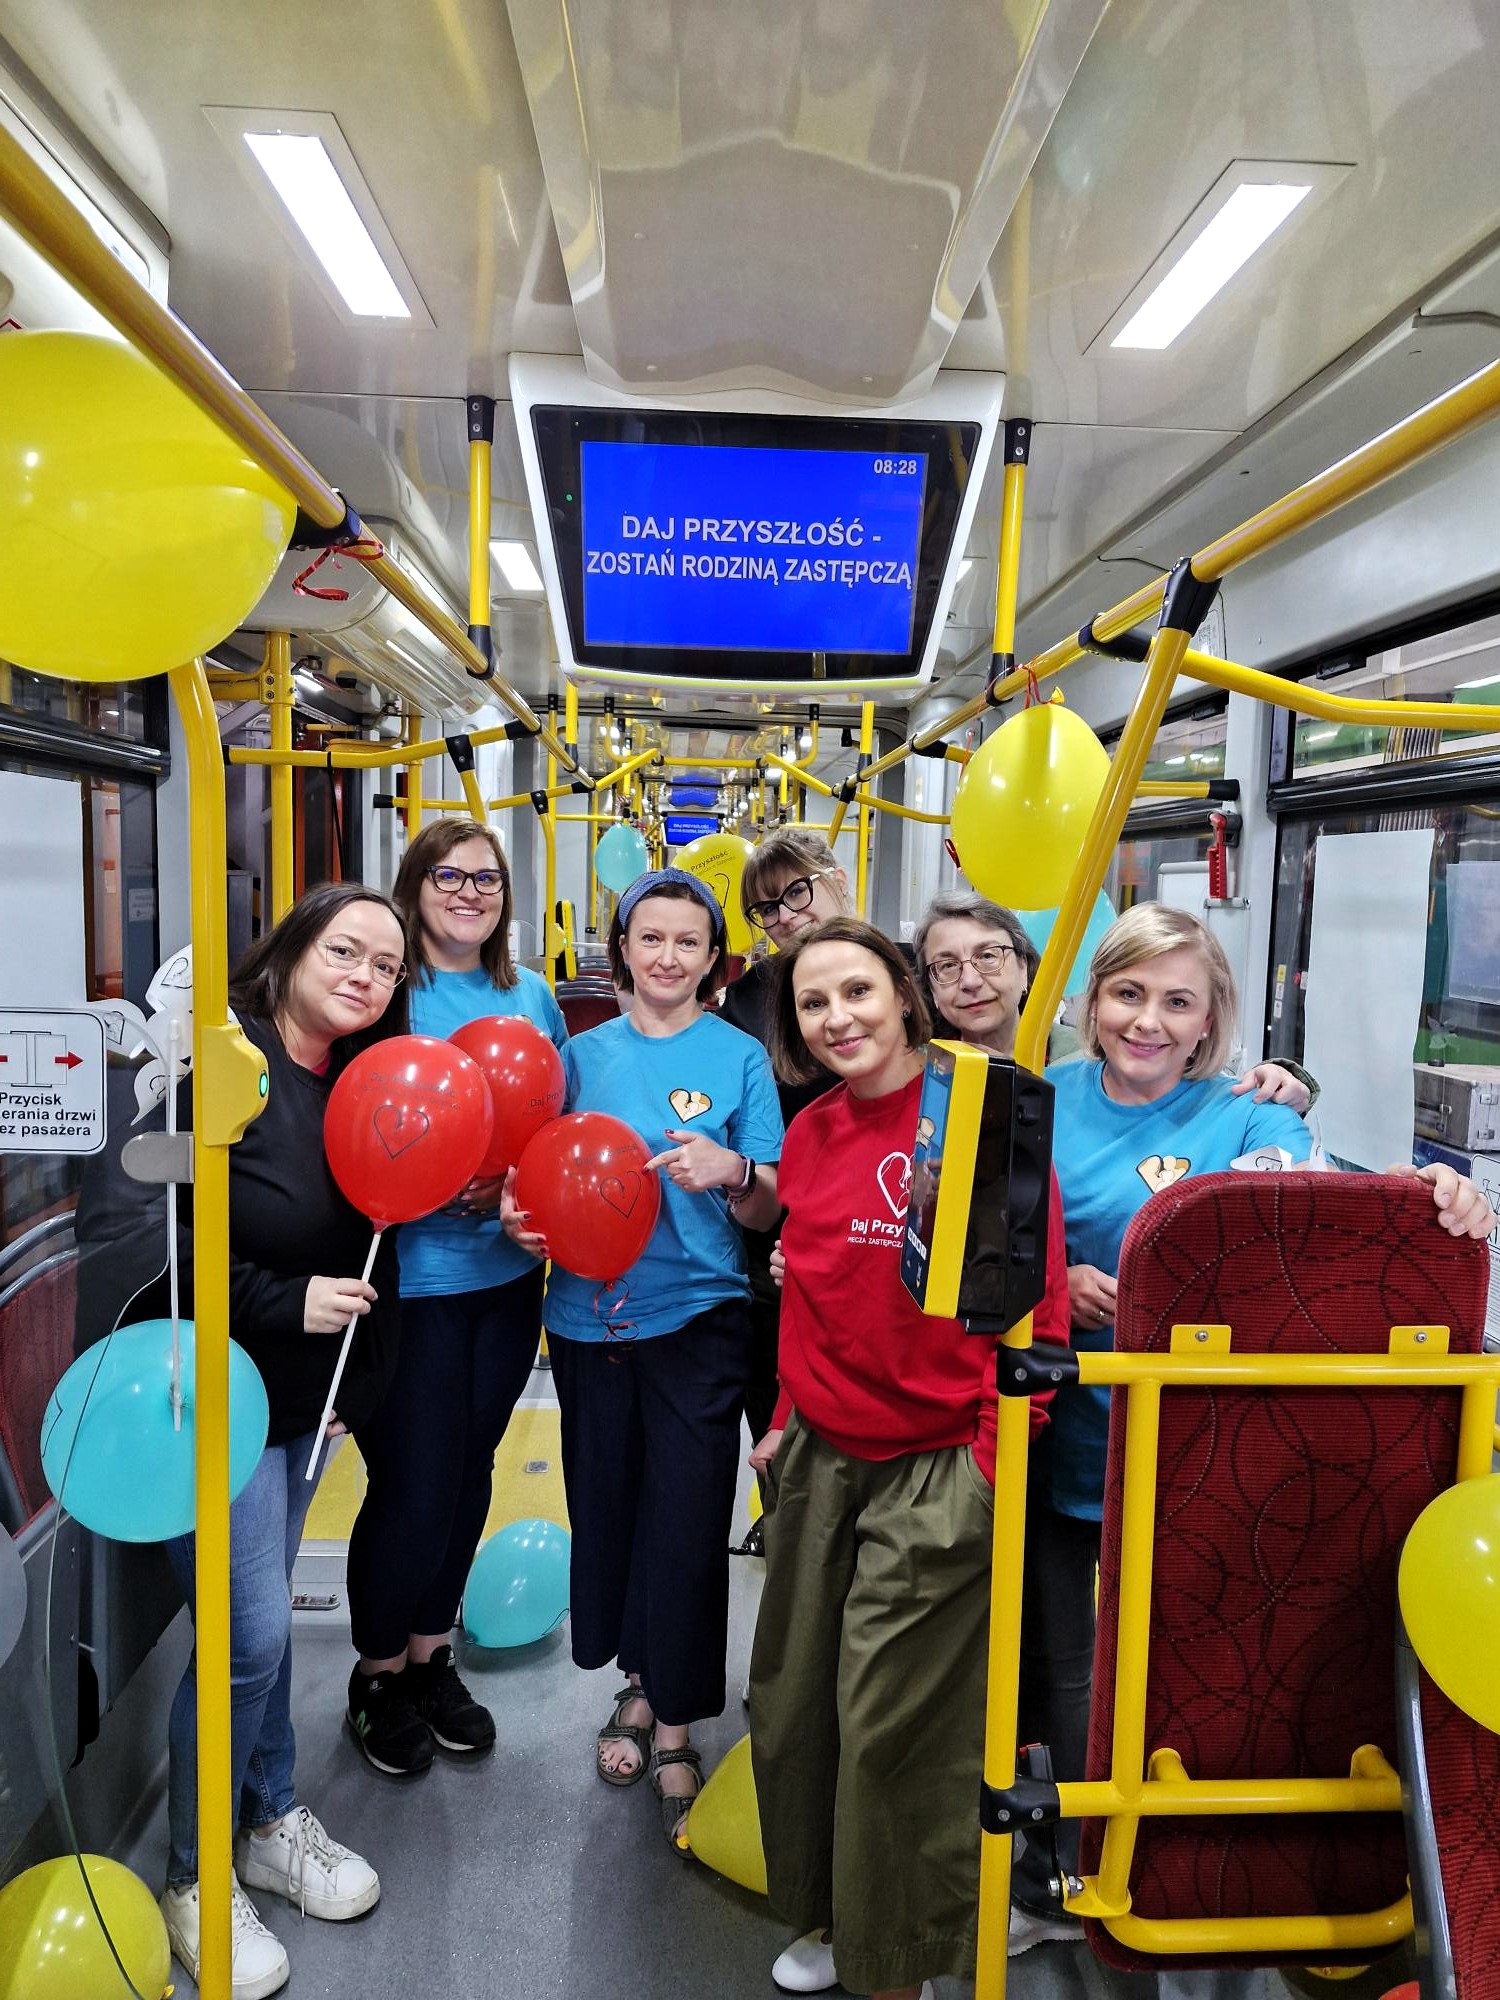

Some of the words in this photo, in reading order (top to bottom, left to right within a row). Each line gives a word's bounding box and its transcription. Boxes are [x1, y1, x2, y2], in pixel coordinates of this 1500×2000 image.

[873, 458, 917, 476] 08:28
[622, 515, 675, 541] DAJ
[684, 517, 865, 547] PRZYSZŁOŚĆ
[586, 548, 675, 577] ZOSTAŃ
[682, 554, 779, 586] RODZINĄ
[783, 558, 912, 590] ZASTĘPCZĄ
[0, 1091, 62, 1108] Przycisk
[1, 1107, 50, 1120] erania
[55, 1108, 96, 1121] drzwi
[0, 1124, 16, 1134] ez
[21, 1123, 91, 1138] pasażera
[851, 1218, 869, 1235] Daj
[872, 1219, 906, 1238] Przy
